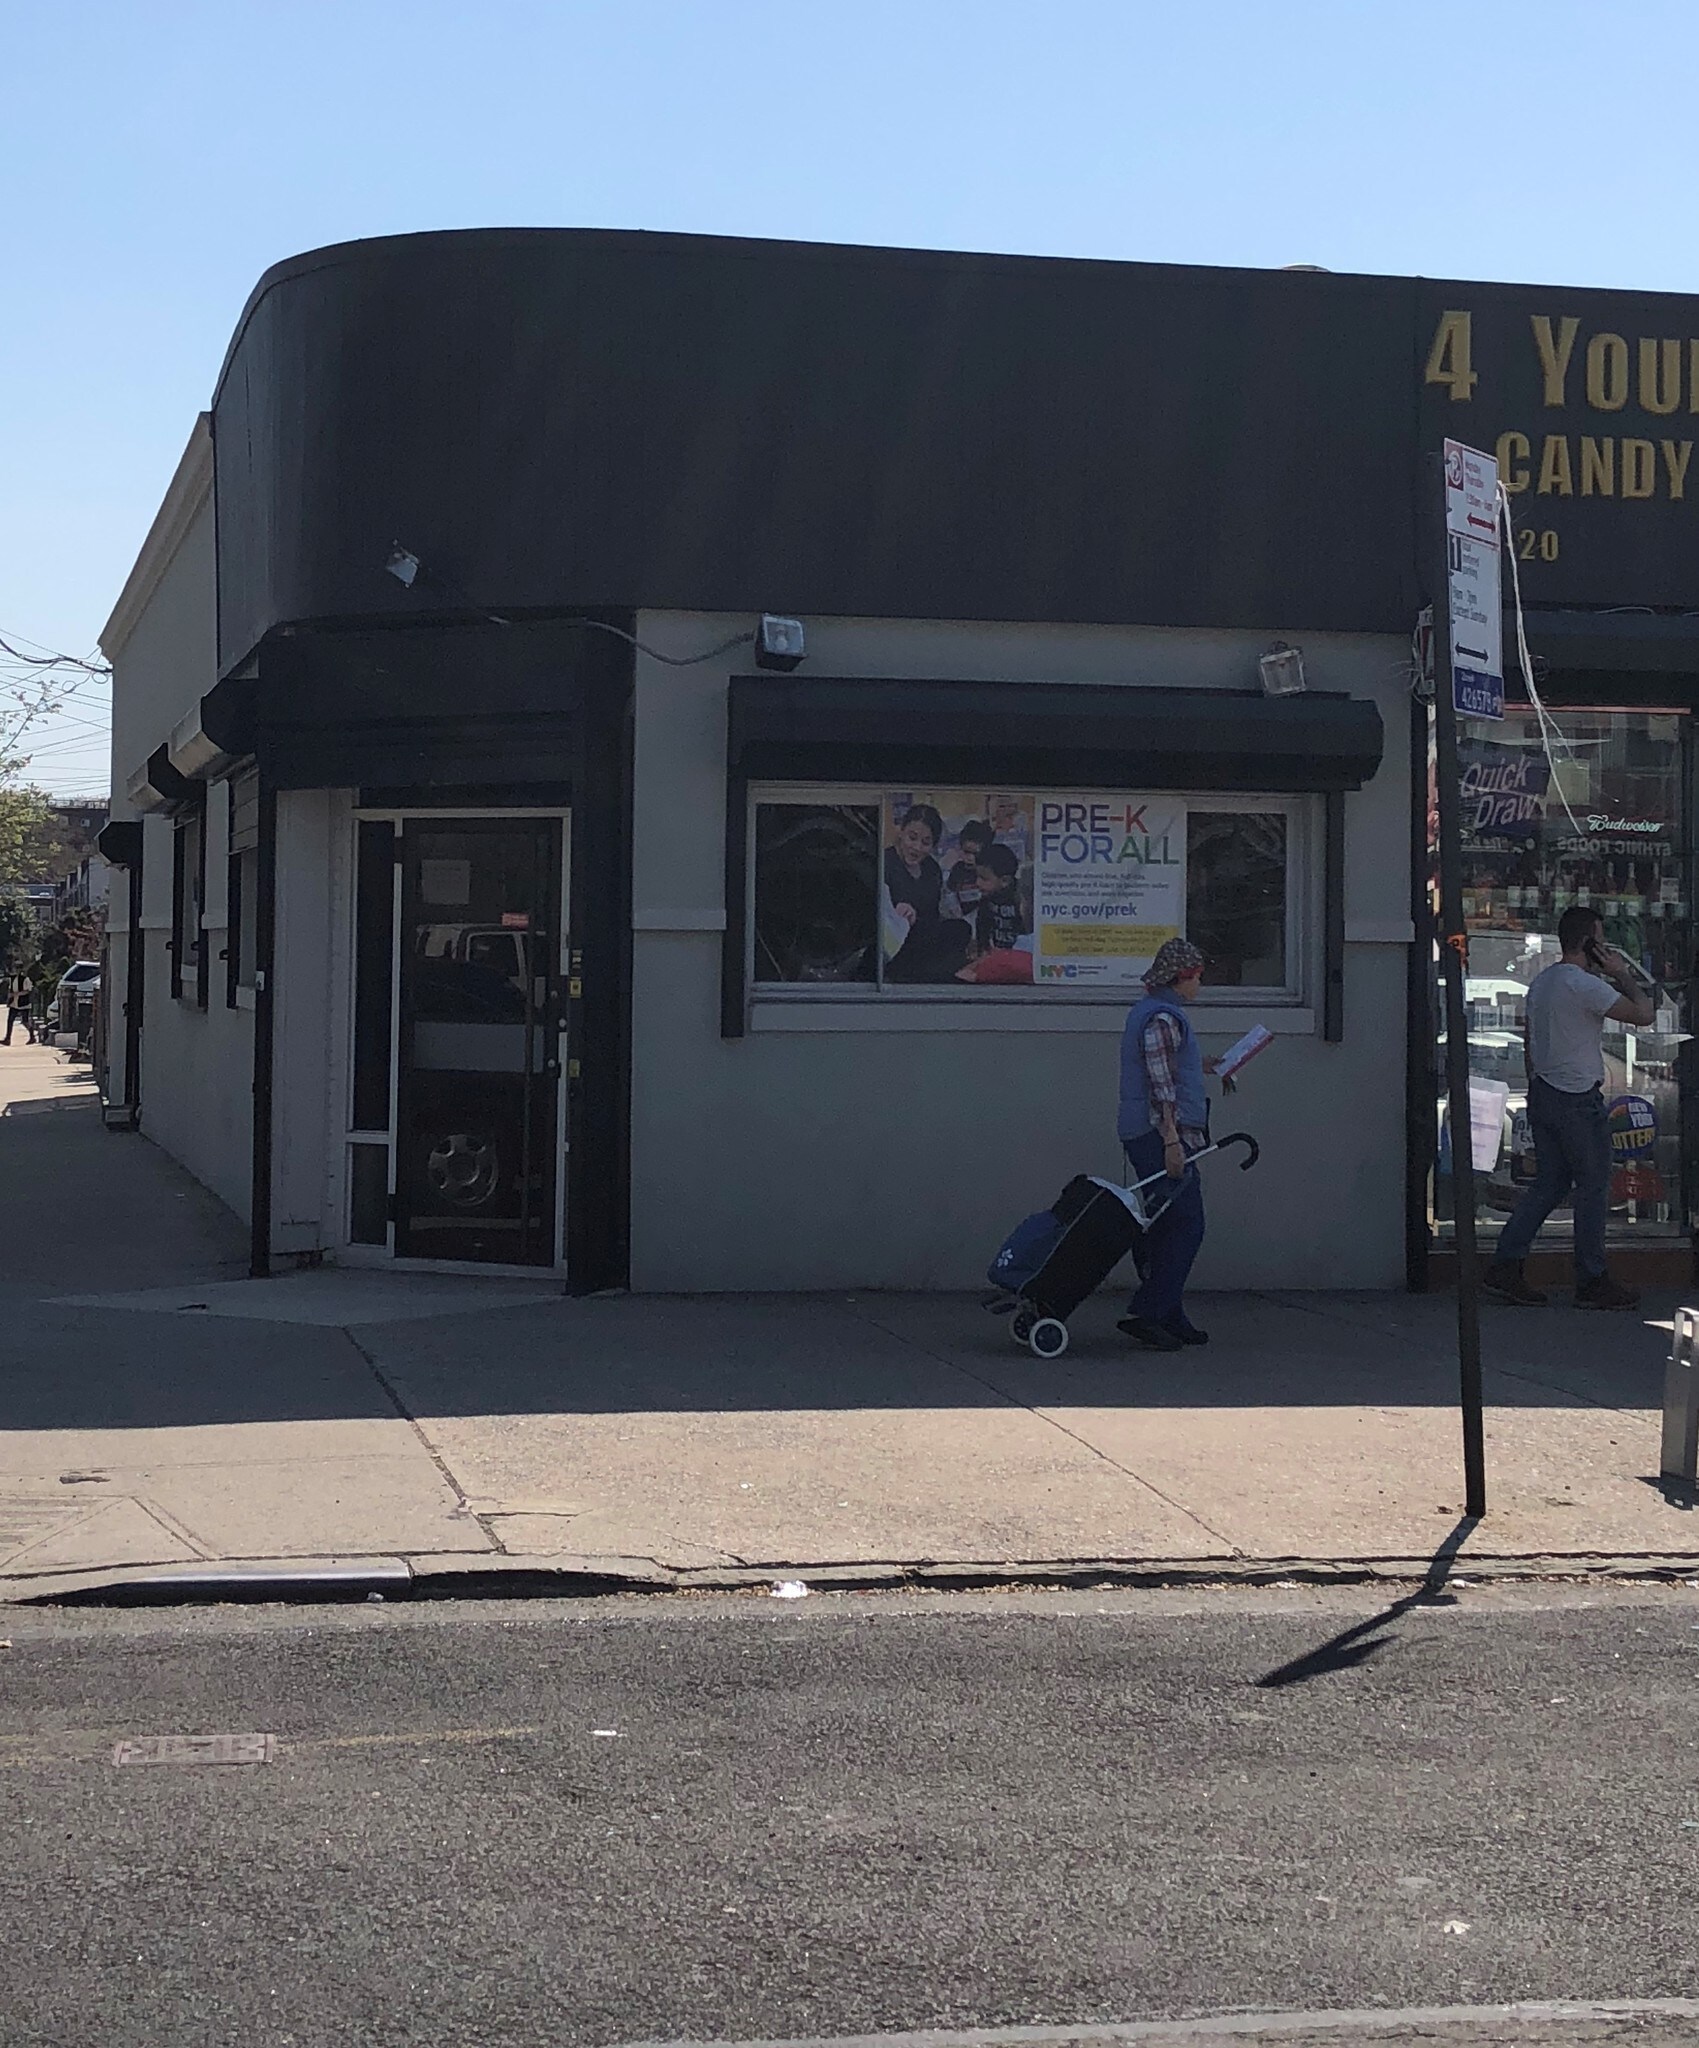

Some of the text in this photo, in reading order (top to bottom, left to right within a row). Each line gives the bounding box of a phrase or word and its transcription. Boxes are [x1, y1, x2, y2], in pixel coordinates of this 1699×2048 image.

[1425, 310, 1478, 401] 4
[1496, 431, 1694, 500] CANDY
[1519, 529, 1559, 562] 20
[1459, 754, 1533, 798] Quick
[1040, 803, 1149, 834] PRE-K
[1473, 794, 1536, 829] Draw
[1040, 834, 1180, 865] FOR ALL
[1041, 902, 1138, 919] nyc.gov/prek
[1040, 964, 1078, 978] NYC
